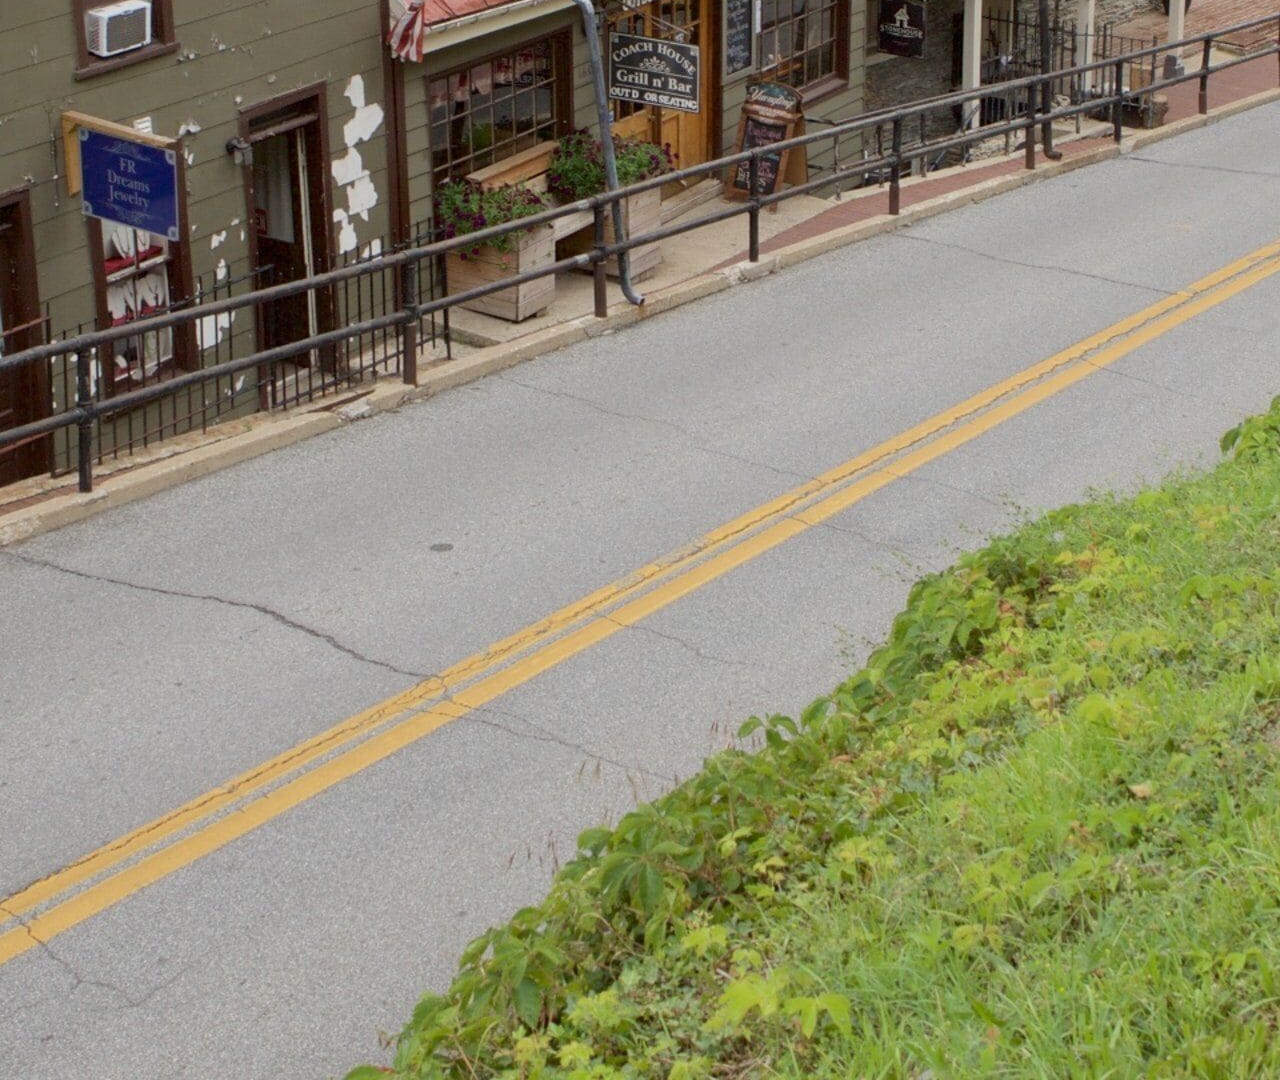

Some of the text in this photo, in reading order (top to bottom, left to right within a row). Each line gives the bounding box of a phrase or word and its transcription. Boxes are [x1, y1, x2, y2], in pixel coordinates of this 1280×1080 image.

[880, 24, 923, 39] STONEHOUSE
[612, 42, 697, 76] COACH HOUSE
[616, 69, 649, 85] Grill
[668, 77, 693, 93] Bar
[658, 94, 698, 109] SEATING
[107, 169, 151, 193] Dreams
[107, 185, 150, 208] Jewelry
